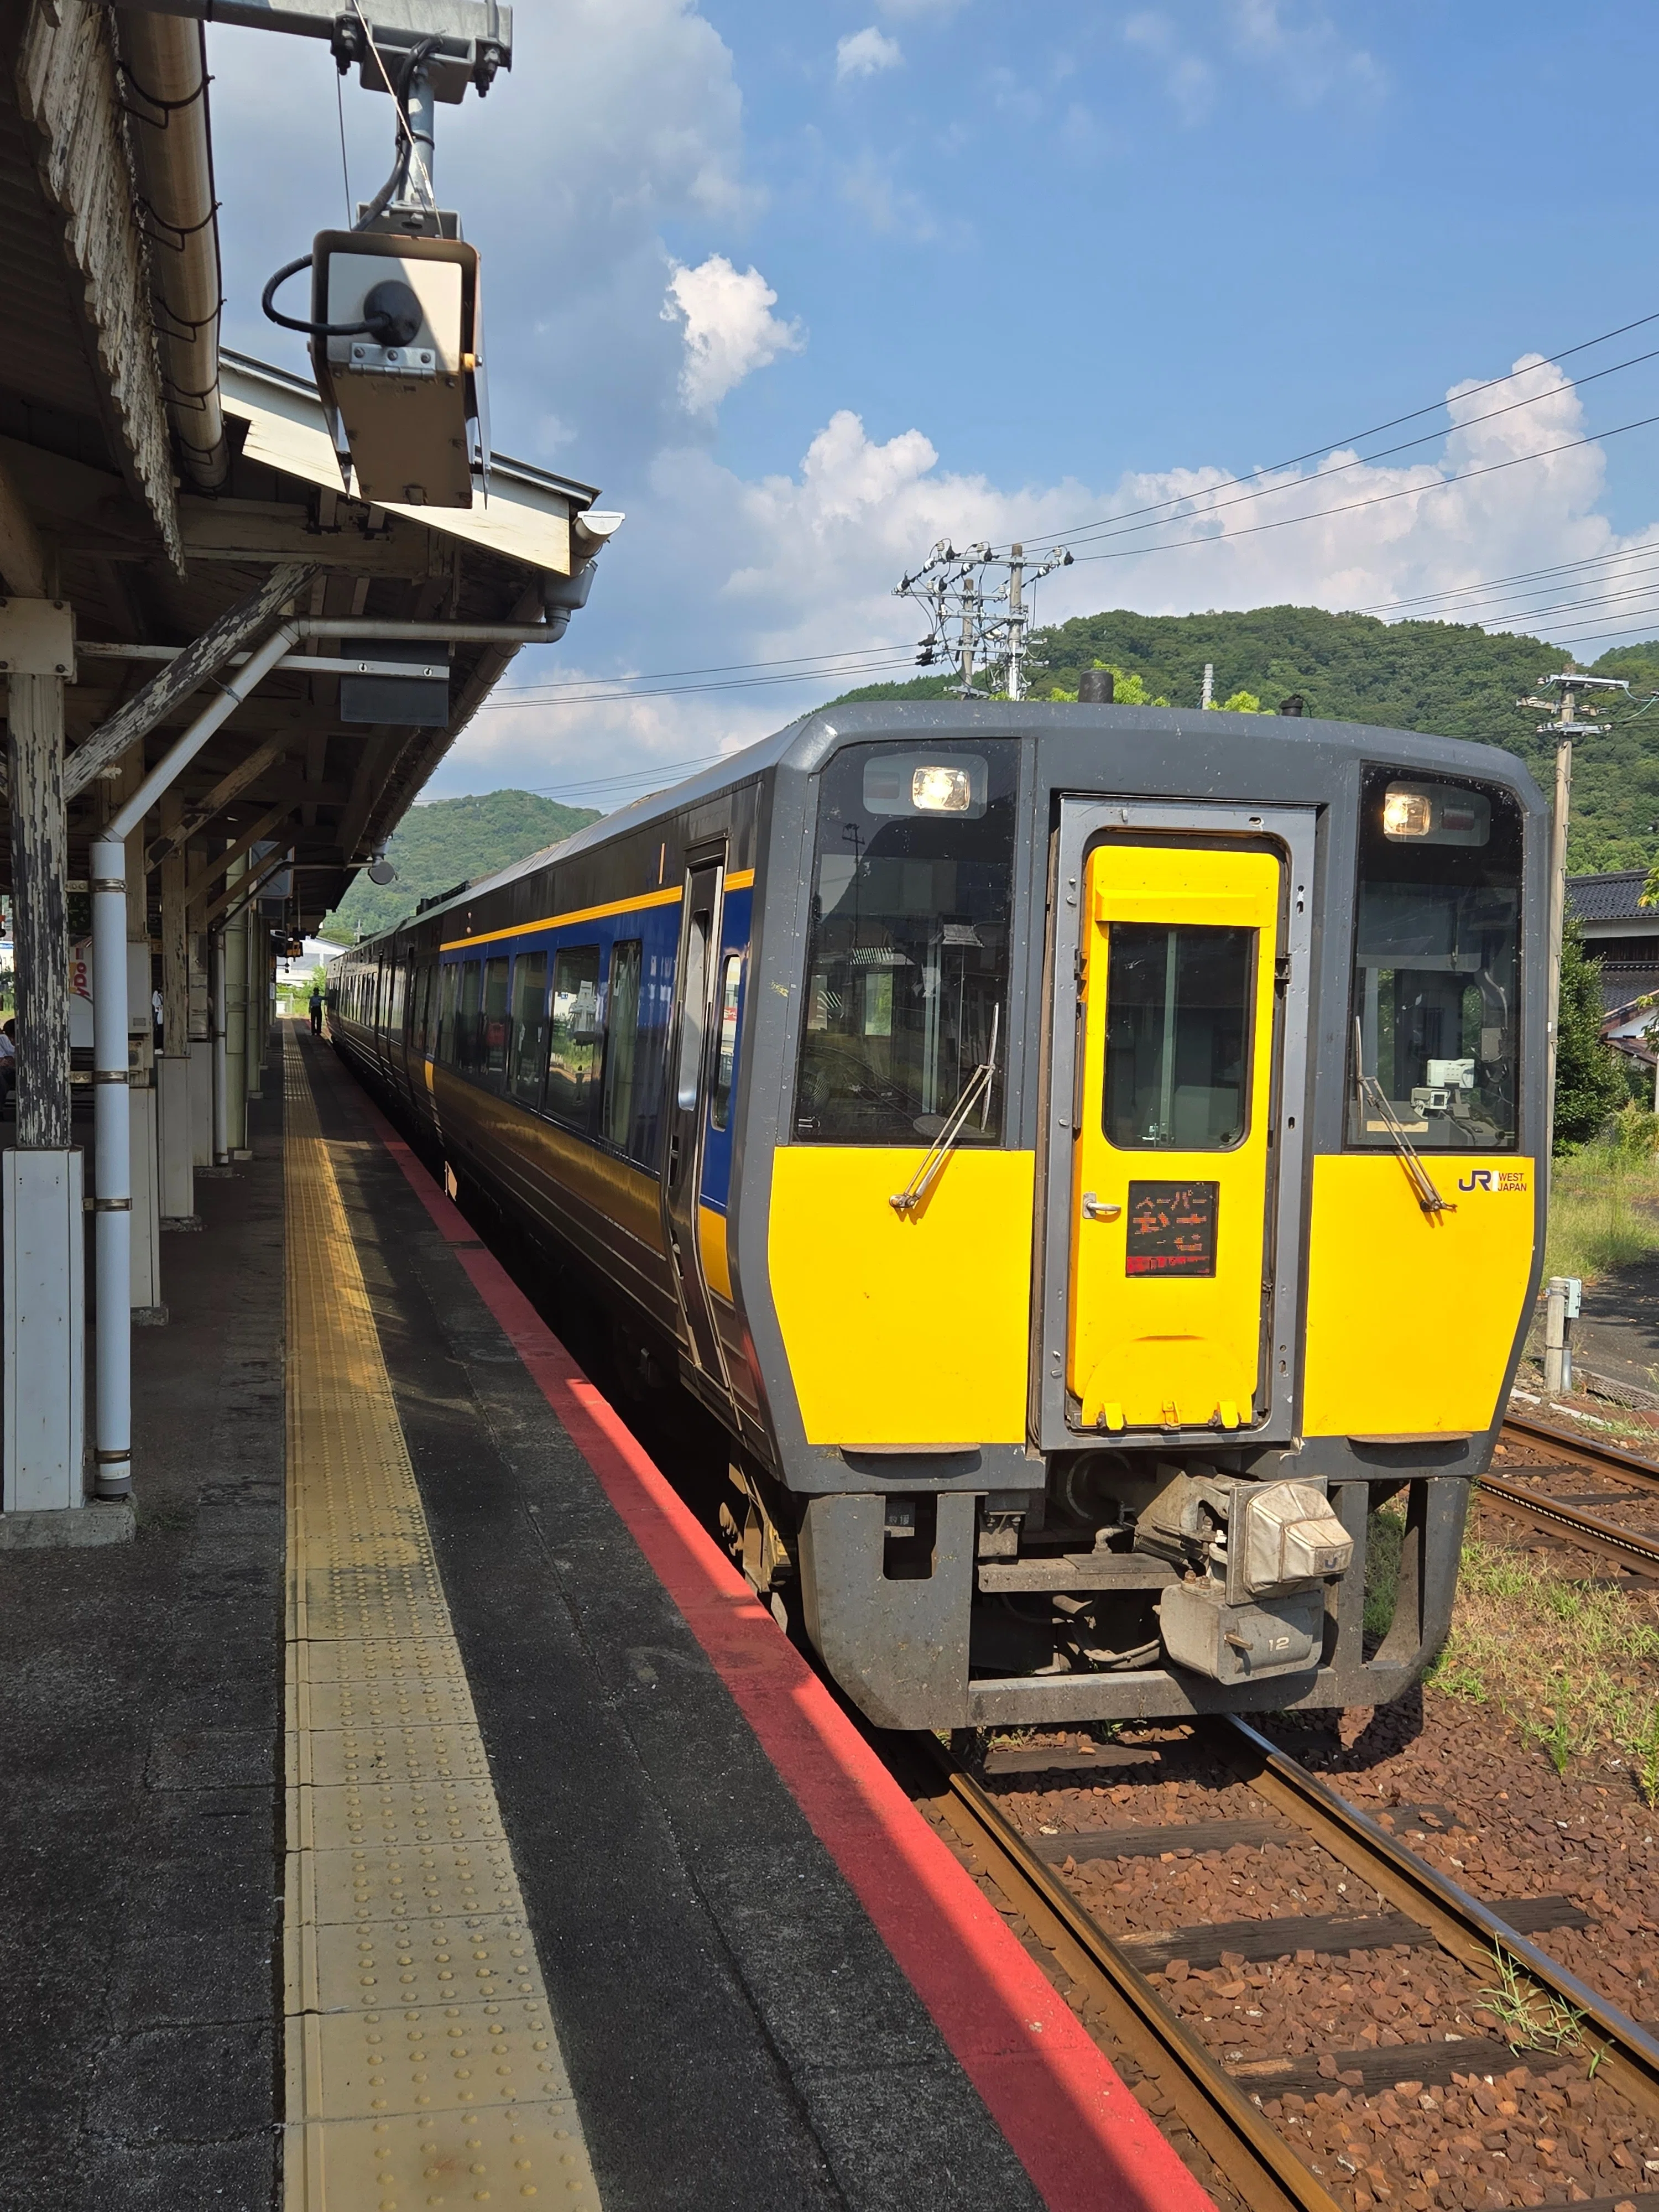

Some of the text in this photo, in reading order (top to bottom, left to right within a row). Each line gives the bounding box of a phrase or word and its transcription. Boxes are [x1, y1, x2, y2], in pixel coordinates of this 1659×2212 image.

[1458, 1170, 1491, 1191] JR
[1499, 1172, 1525, 1182] WEST
[1498, 1183, 1527, 1192] JAPAN
[1269, 1637, 1290, 1652] 12
